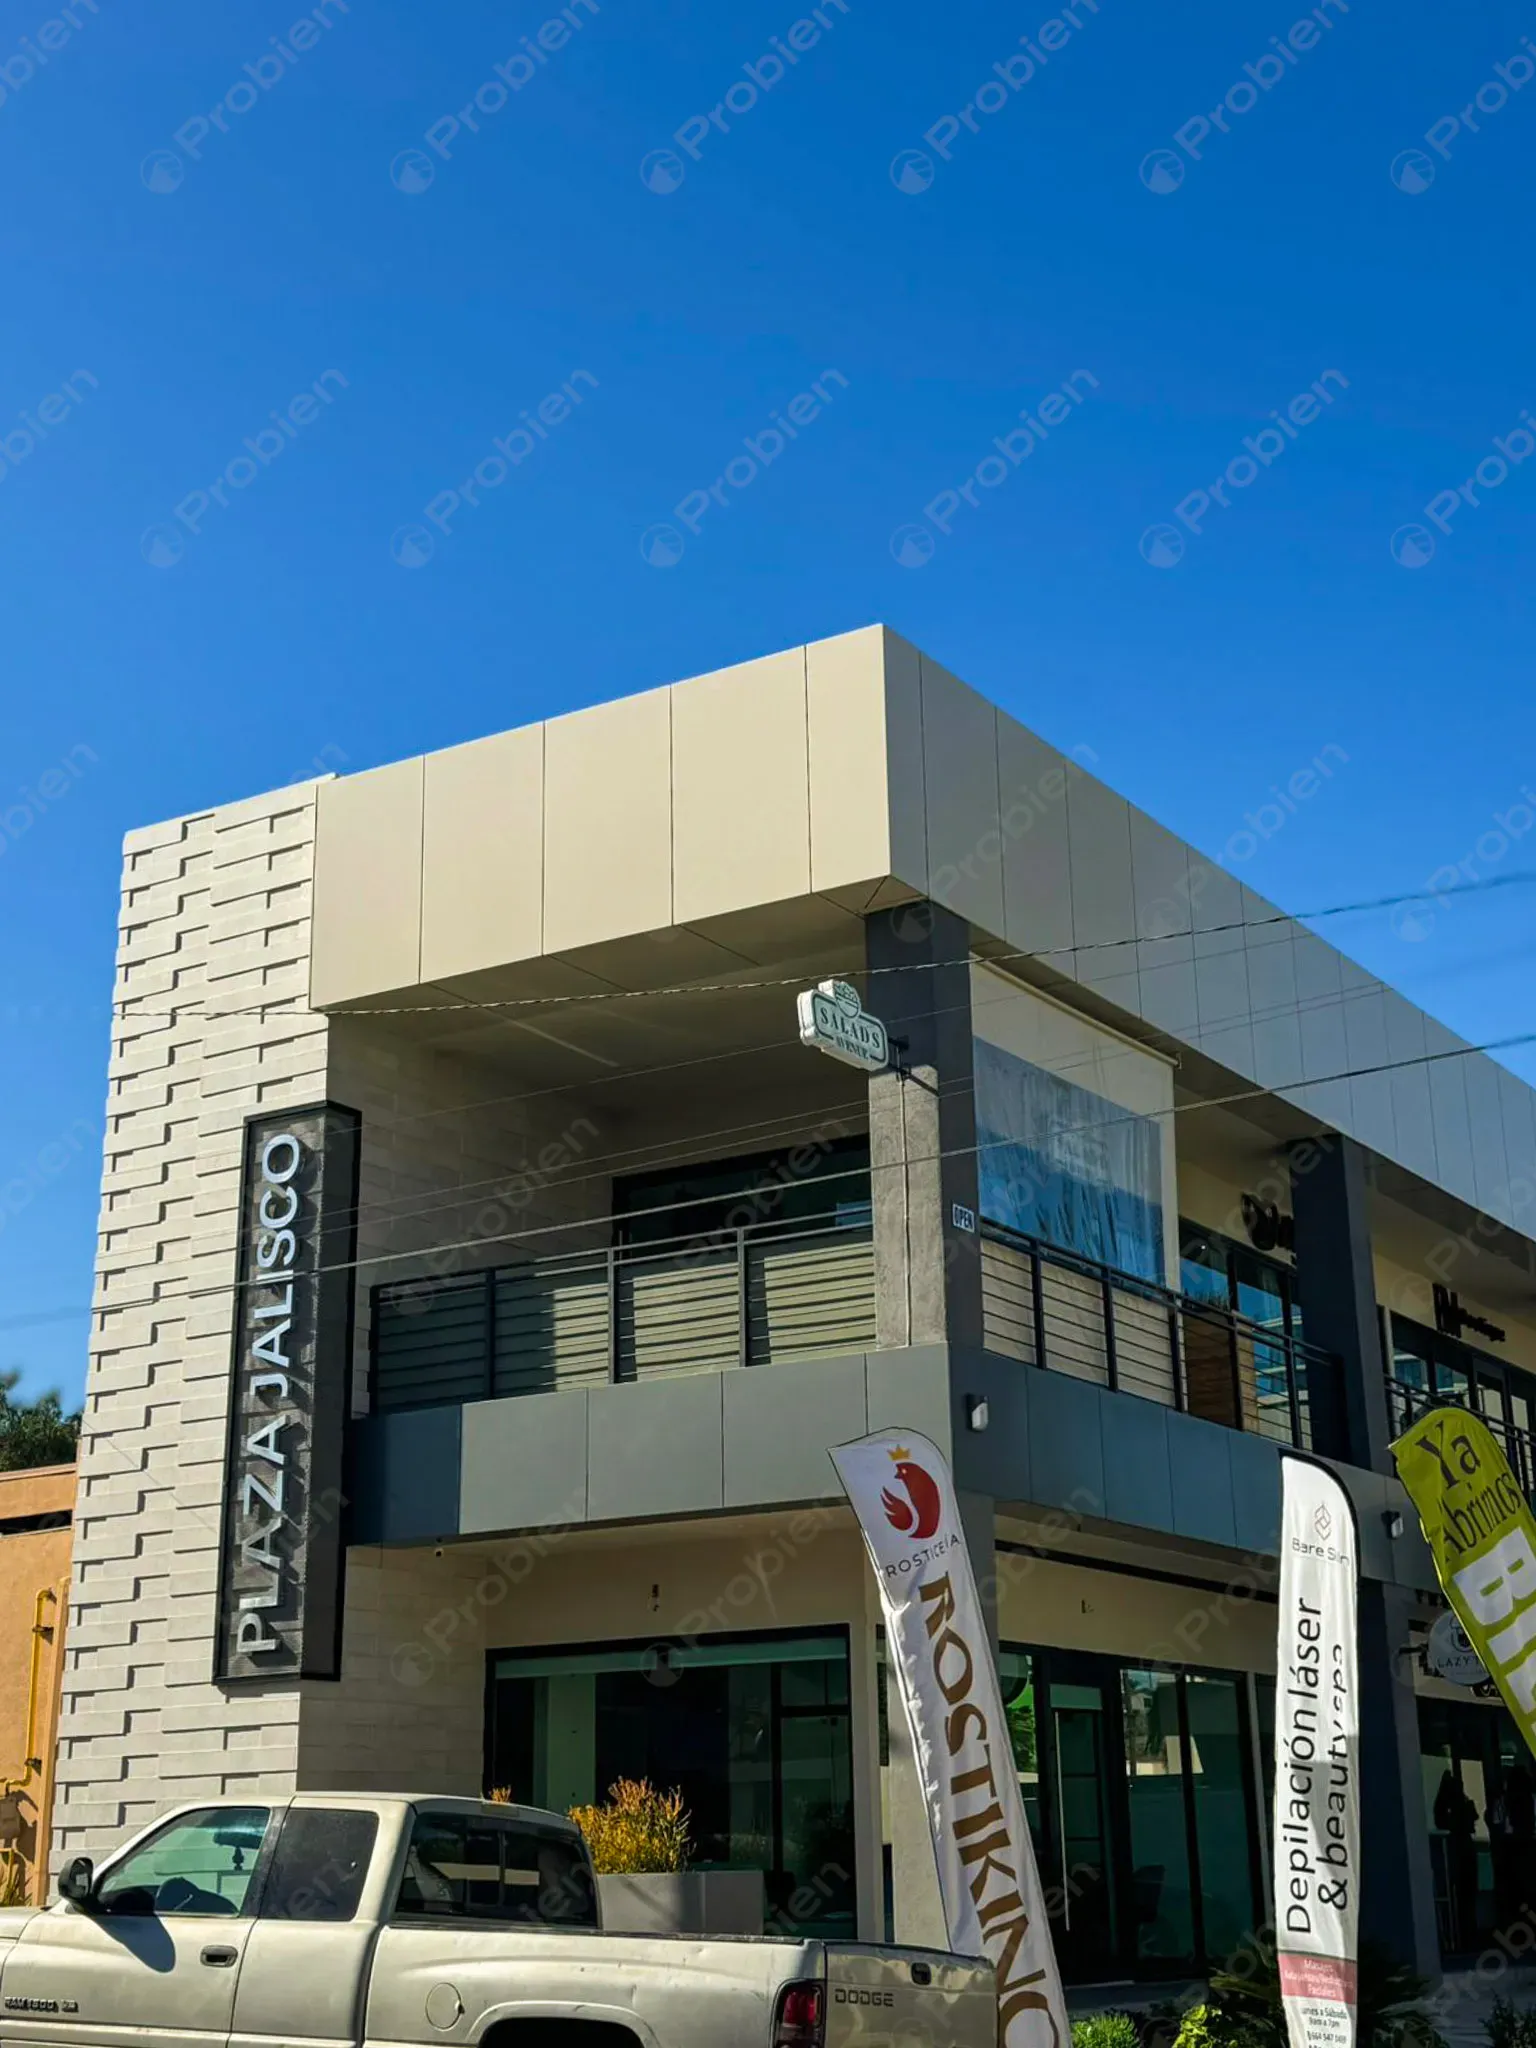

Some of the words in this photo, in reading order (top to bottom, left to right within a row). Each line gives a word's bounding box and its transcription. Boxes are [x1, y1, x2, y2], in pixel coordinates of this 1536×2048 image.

[820, 1007, 881, 1049] SALADS
[955, 1206, 973, 1230] OPEN
[249, 1132, 301, 1400] JALISCO
[1415, 1420, 1481, 1489] Ya
[236, 1415, 290, 1657] PLAZA
[1292, 1537, 1324, 1557] Bare
[1287, 1597, 1321, 1699] láser
[1282, 1709, 1317, 1933] Depilación
[1316, 1720, 1348, 1868] beauty
[1317, 1879, 1348, 1911] &
[835, 1988, 894, 2008] DODGE
